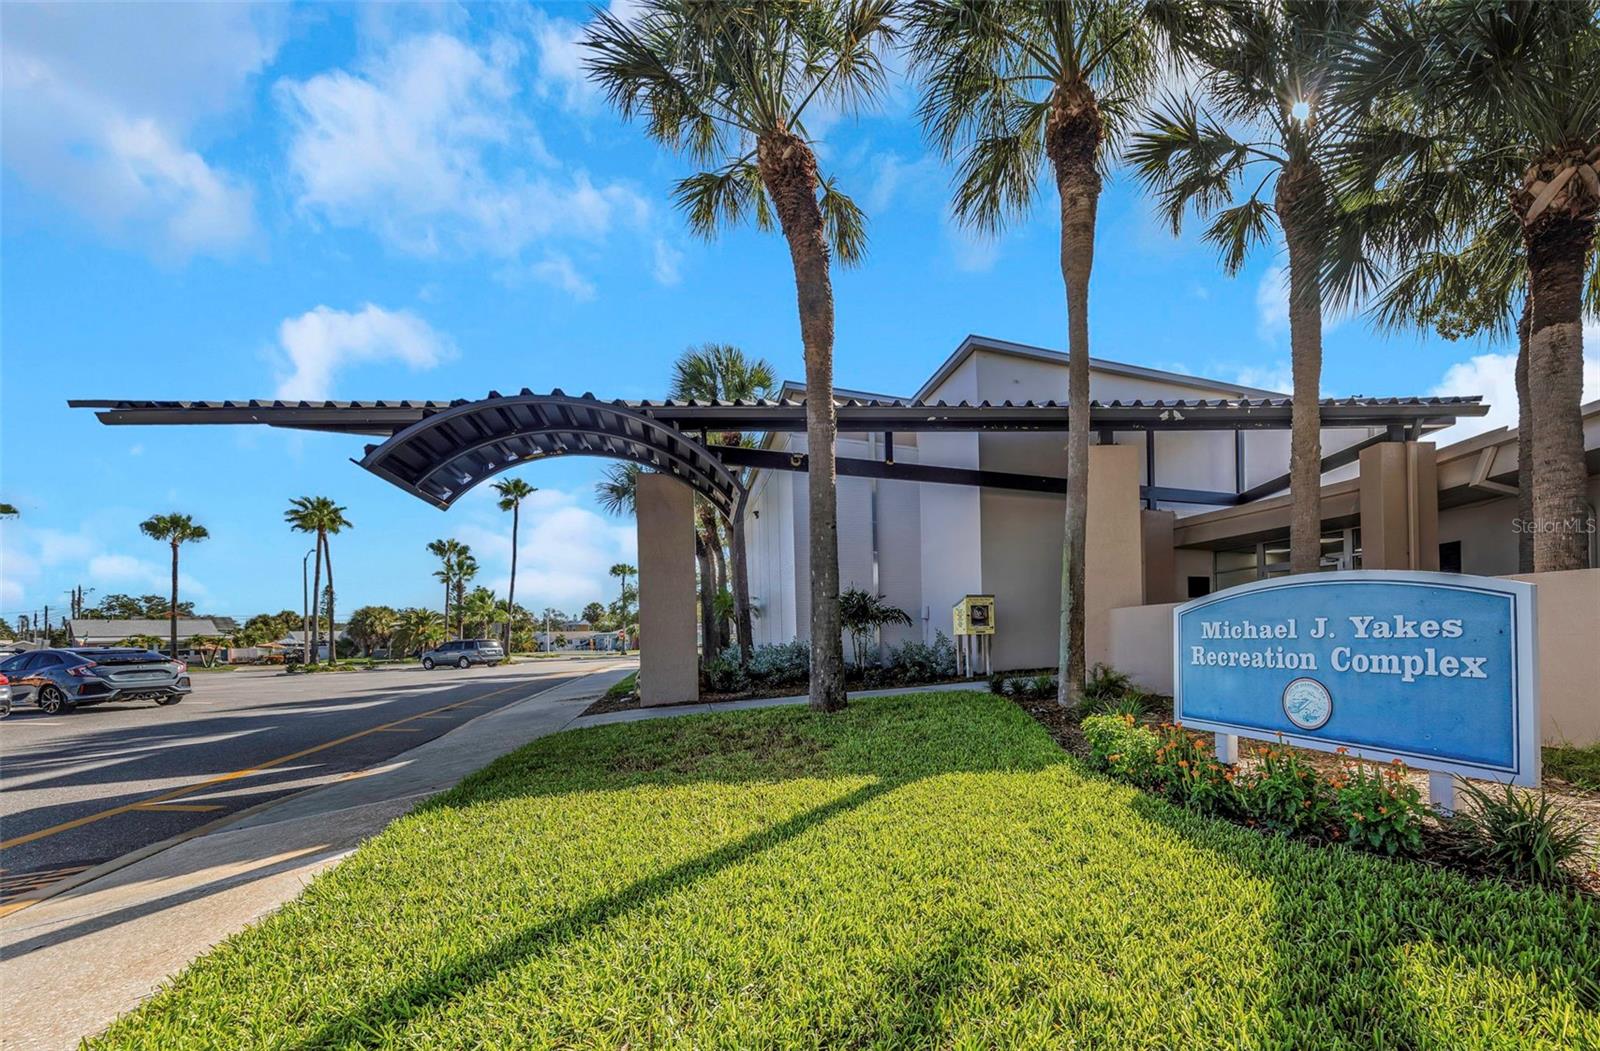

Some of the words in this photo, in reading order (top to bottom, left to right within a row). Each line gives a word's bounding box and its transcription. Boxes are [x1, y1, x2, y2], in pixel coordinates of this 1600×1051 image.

[1201, 618, 1298, 640] Michael
[1310, 617, 1335, 639] J.
[1349, 615, 1464, 639] Yakes
[1191, 646, 1318, 670] Recreation
[1330, 647, 1488, 682] Complex
